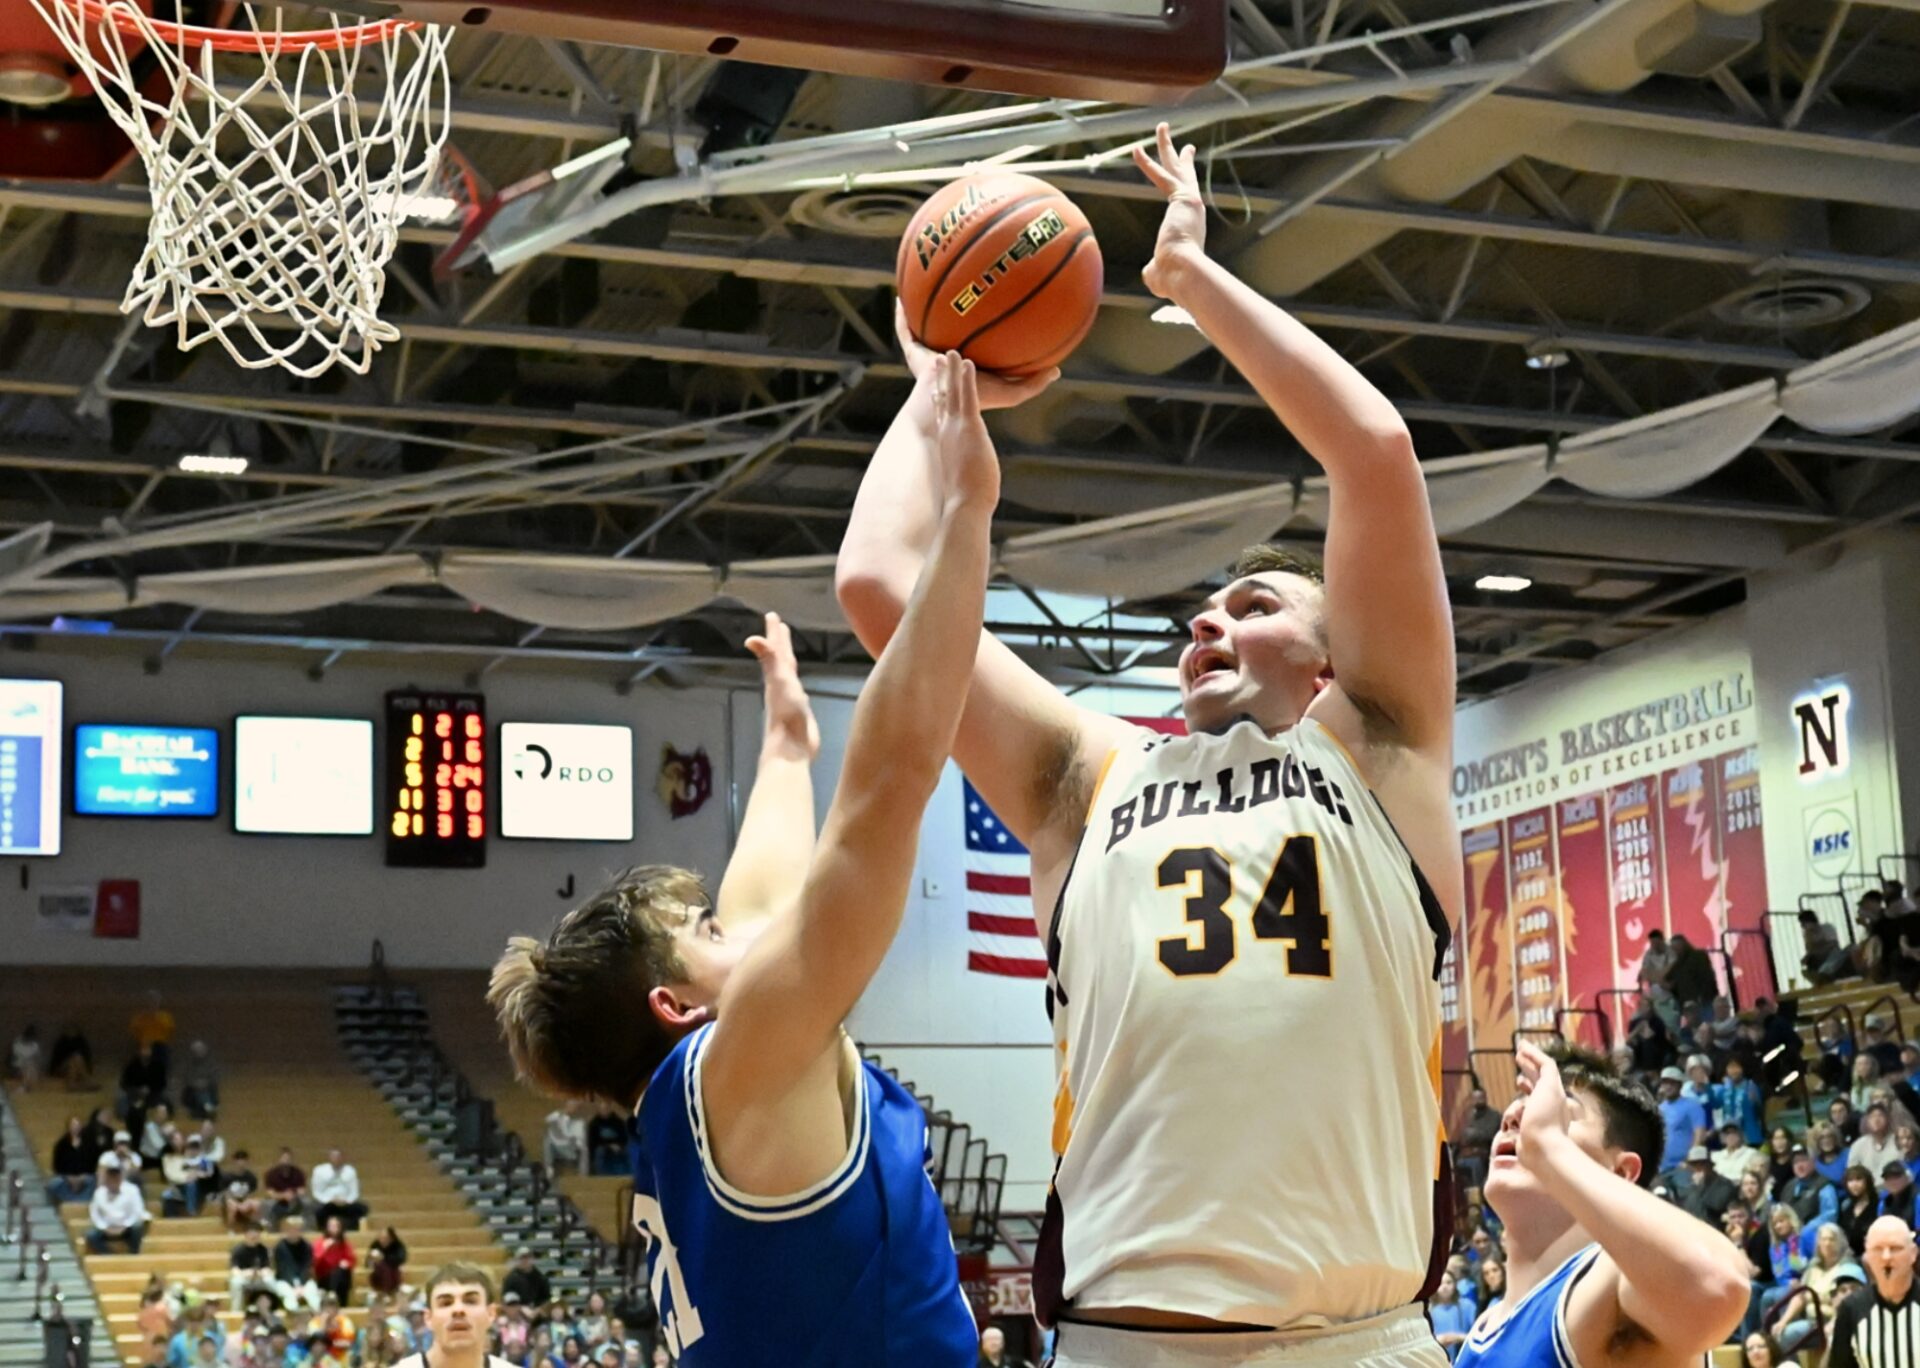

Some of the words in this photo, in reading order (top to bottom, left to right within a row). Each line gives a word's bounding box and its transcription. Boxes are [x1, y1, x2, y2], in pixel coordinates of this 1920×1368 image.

[951, 237, 1034, 316] ELITE
[1026, 208, 1066, 252] PRO
[1452, 737, 1549, 799] OMEN'S
[1560, 674, 1753, 765] BASKETBALL
[1456, 774, 1560, 820] TRADITION
[1569, 765, 1593, 786] OF
[1602, 719, 1741, 776] EXCELLENCE
[1795, 694, 1840, 775] N
[1616, 816, 1648, 842] 2014
[1617, 836, 1649, 862] 2015
[1813, 830, 1850, 856] NSIC
[556, 873, 575, 900] J
[1156, 832, 1334, 980] 34
